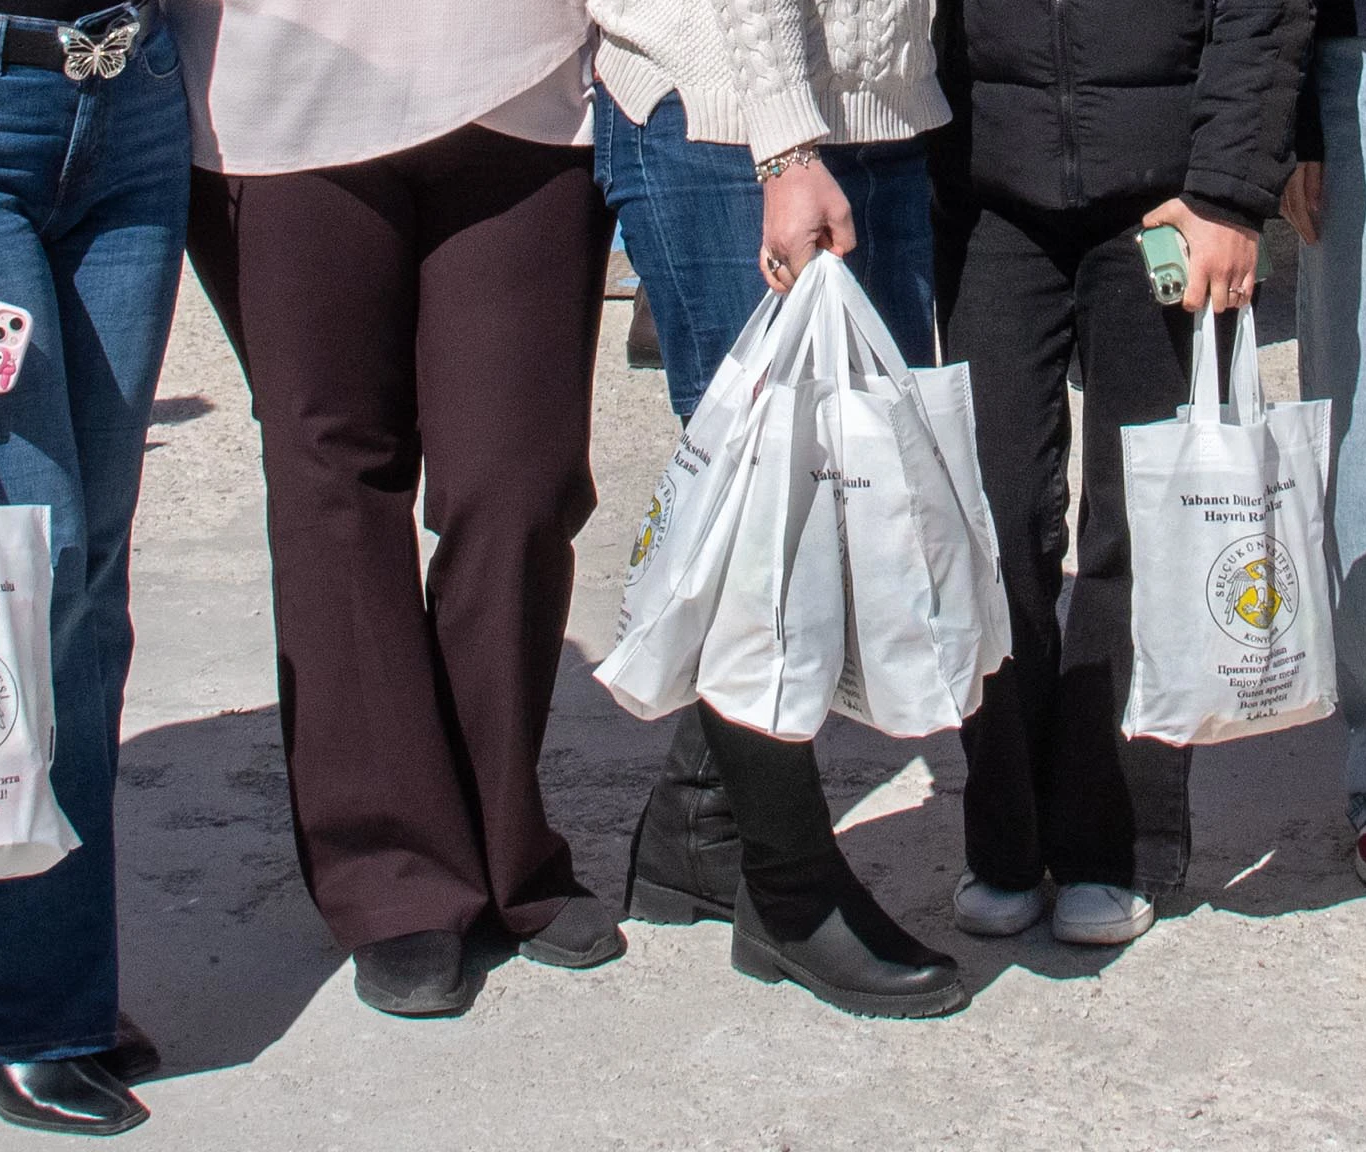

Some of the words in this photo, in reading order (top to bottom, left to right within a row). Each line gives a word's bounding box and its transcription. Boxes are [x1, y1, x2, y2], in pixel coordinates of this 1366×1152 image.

[1180, 495, 1229, 506] Yabancı
[1233, 494, 1262, 507] Diller
[1204, 511, 1245, 524] Hayırlı
